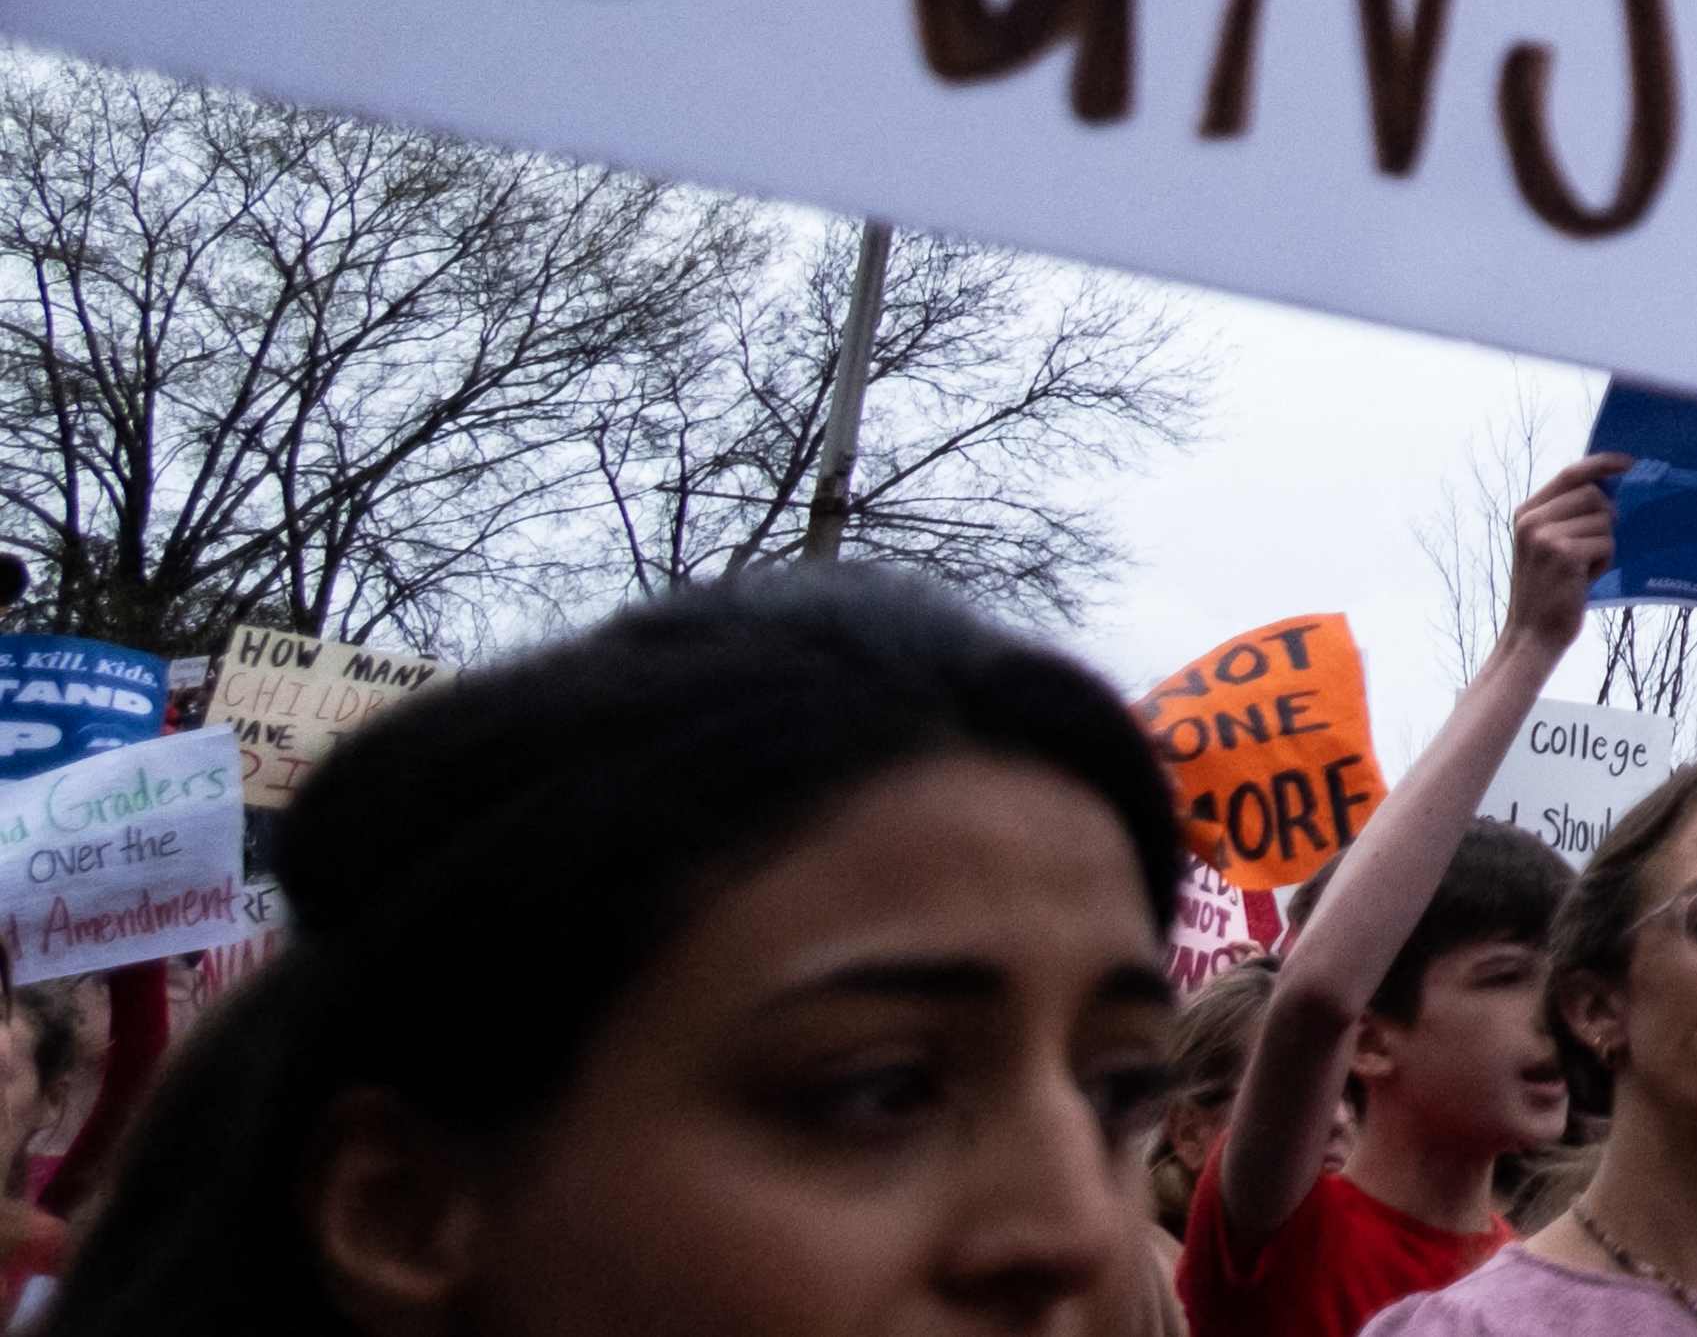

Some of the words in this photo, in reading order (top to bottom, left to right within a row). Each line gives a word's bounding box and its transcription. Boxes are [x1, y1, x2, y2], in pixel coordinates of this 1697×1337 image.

[239, 630, 323, 669] HOW
[342, 652, 435, 692] MANY
[1143, 623, 1321, 723] NOT
[1160, 688, 1331, 764] ONE
[46, 767, 227, 832] Graders
[119, 824, 182, 865] the
[41, 877, 240, 957] Amendment
